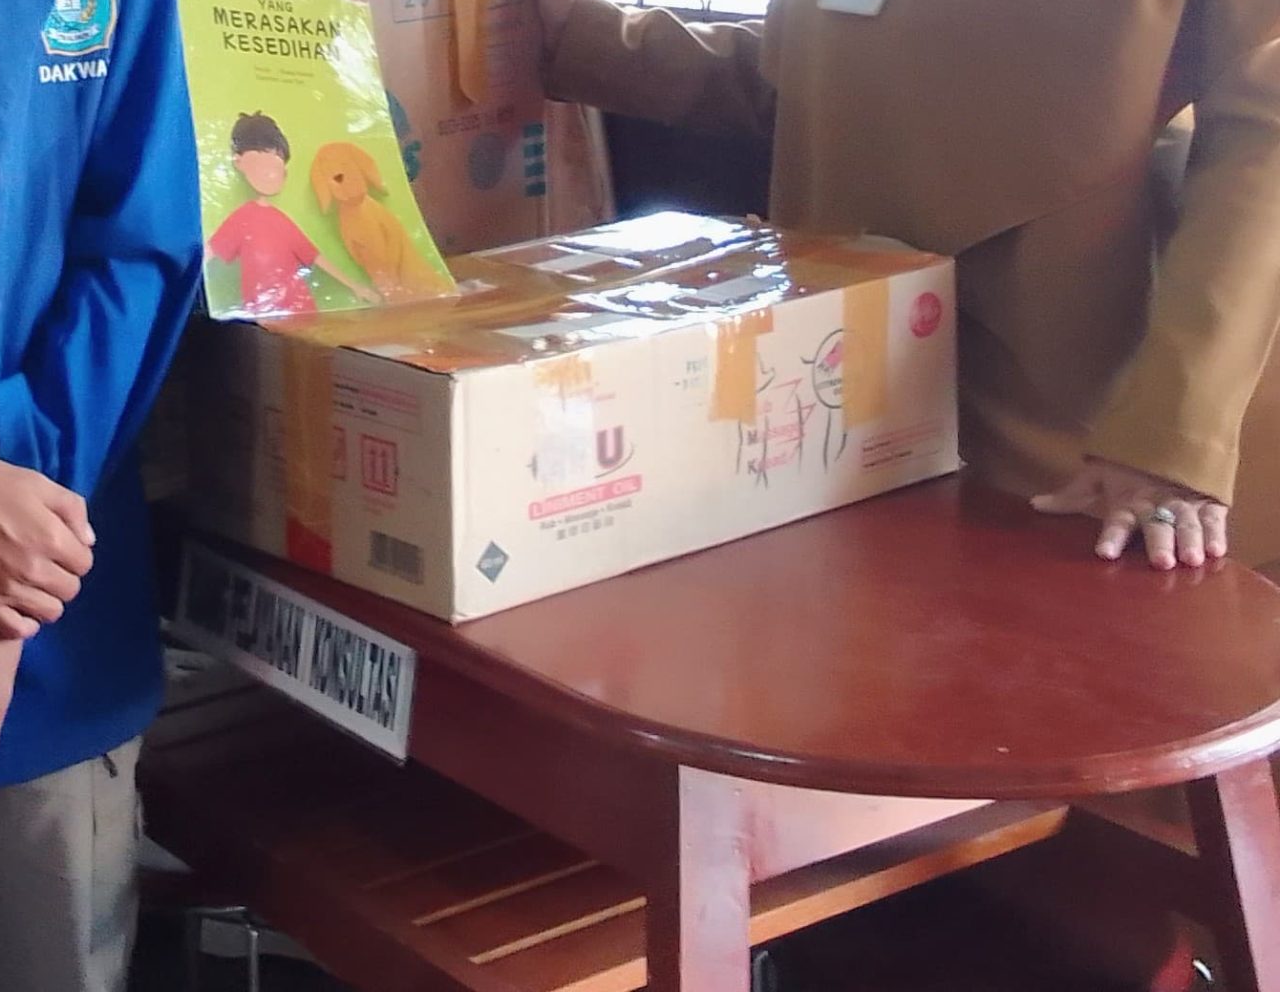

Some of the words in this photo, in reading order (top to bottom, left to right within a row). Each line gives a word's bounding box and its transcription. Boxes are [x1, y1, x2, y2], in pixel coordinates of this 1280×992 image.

[258, 0, 294, 13] YANG
[213, 6, 341, 38] MERASAKAN
[38, 58, 108, 83] DAKWA
